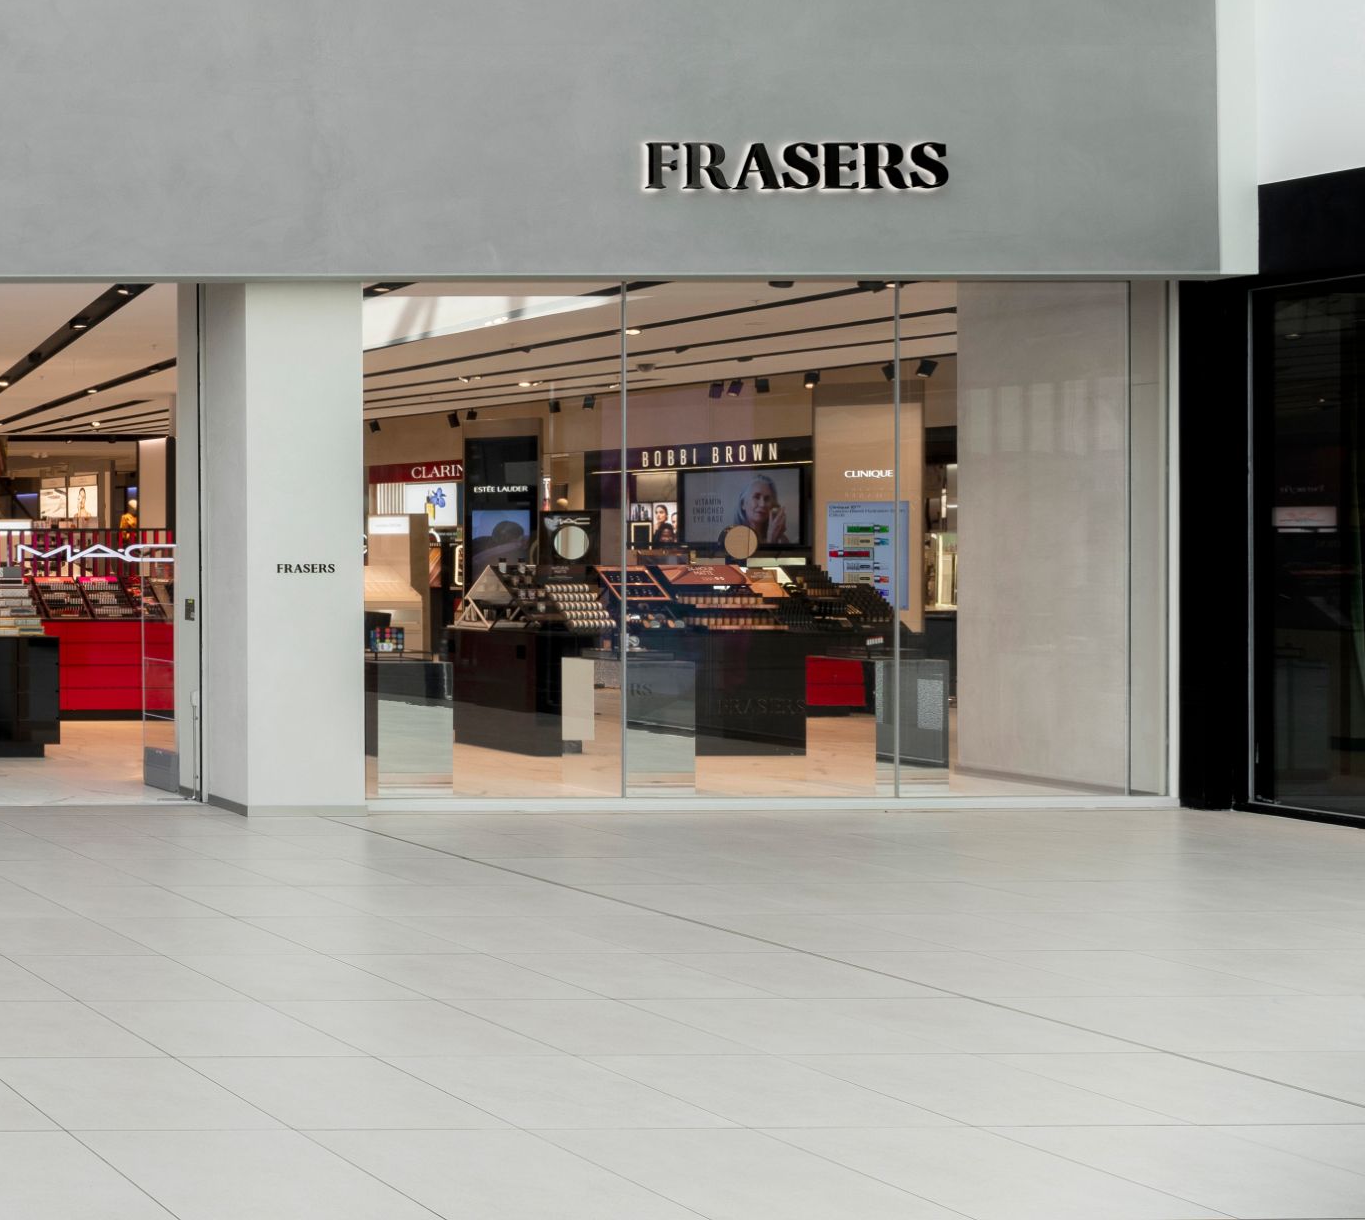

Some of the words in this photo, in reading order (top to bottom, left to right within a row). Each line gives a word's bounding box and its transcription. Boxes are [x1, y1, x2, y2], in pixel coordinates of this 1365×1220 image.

[645, 141, 950, 191] FRASERS
[642, 447, 698, 468] BOBBI
[711, 442, 779, 464] BROWN
[844, 469, 894, 479] CLINIQUE
[473, 485, 496, 493] ESTÉE
[497, 484, 529, 493] LAUDER
[277, 563, 336, 574] FRASERS
